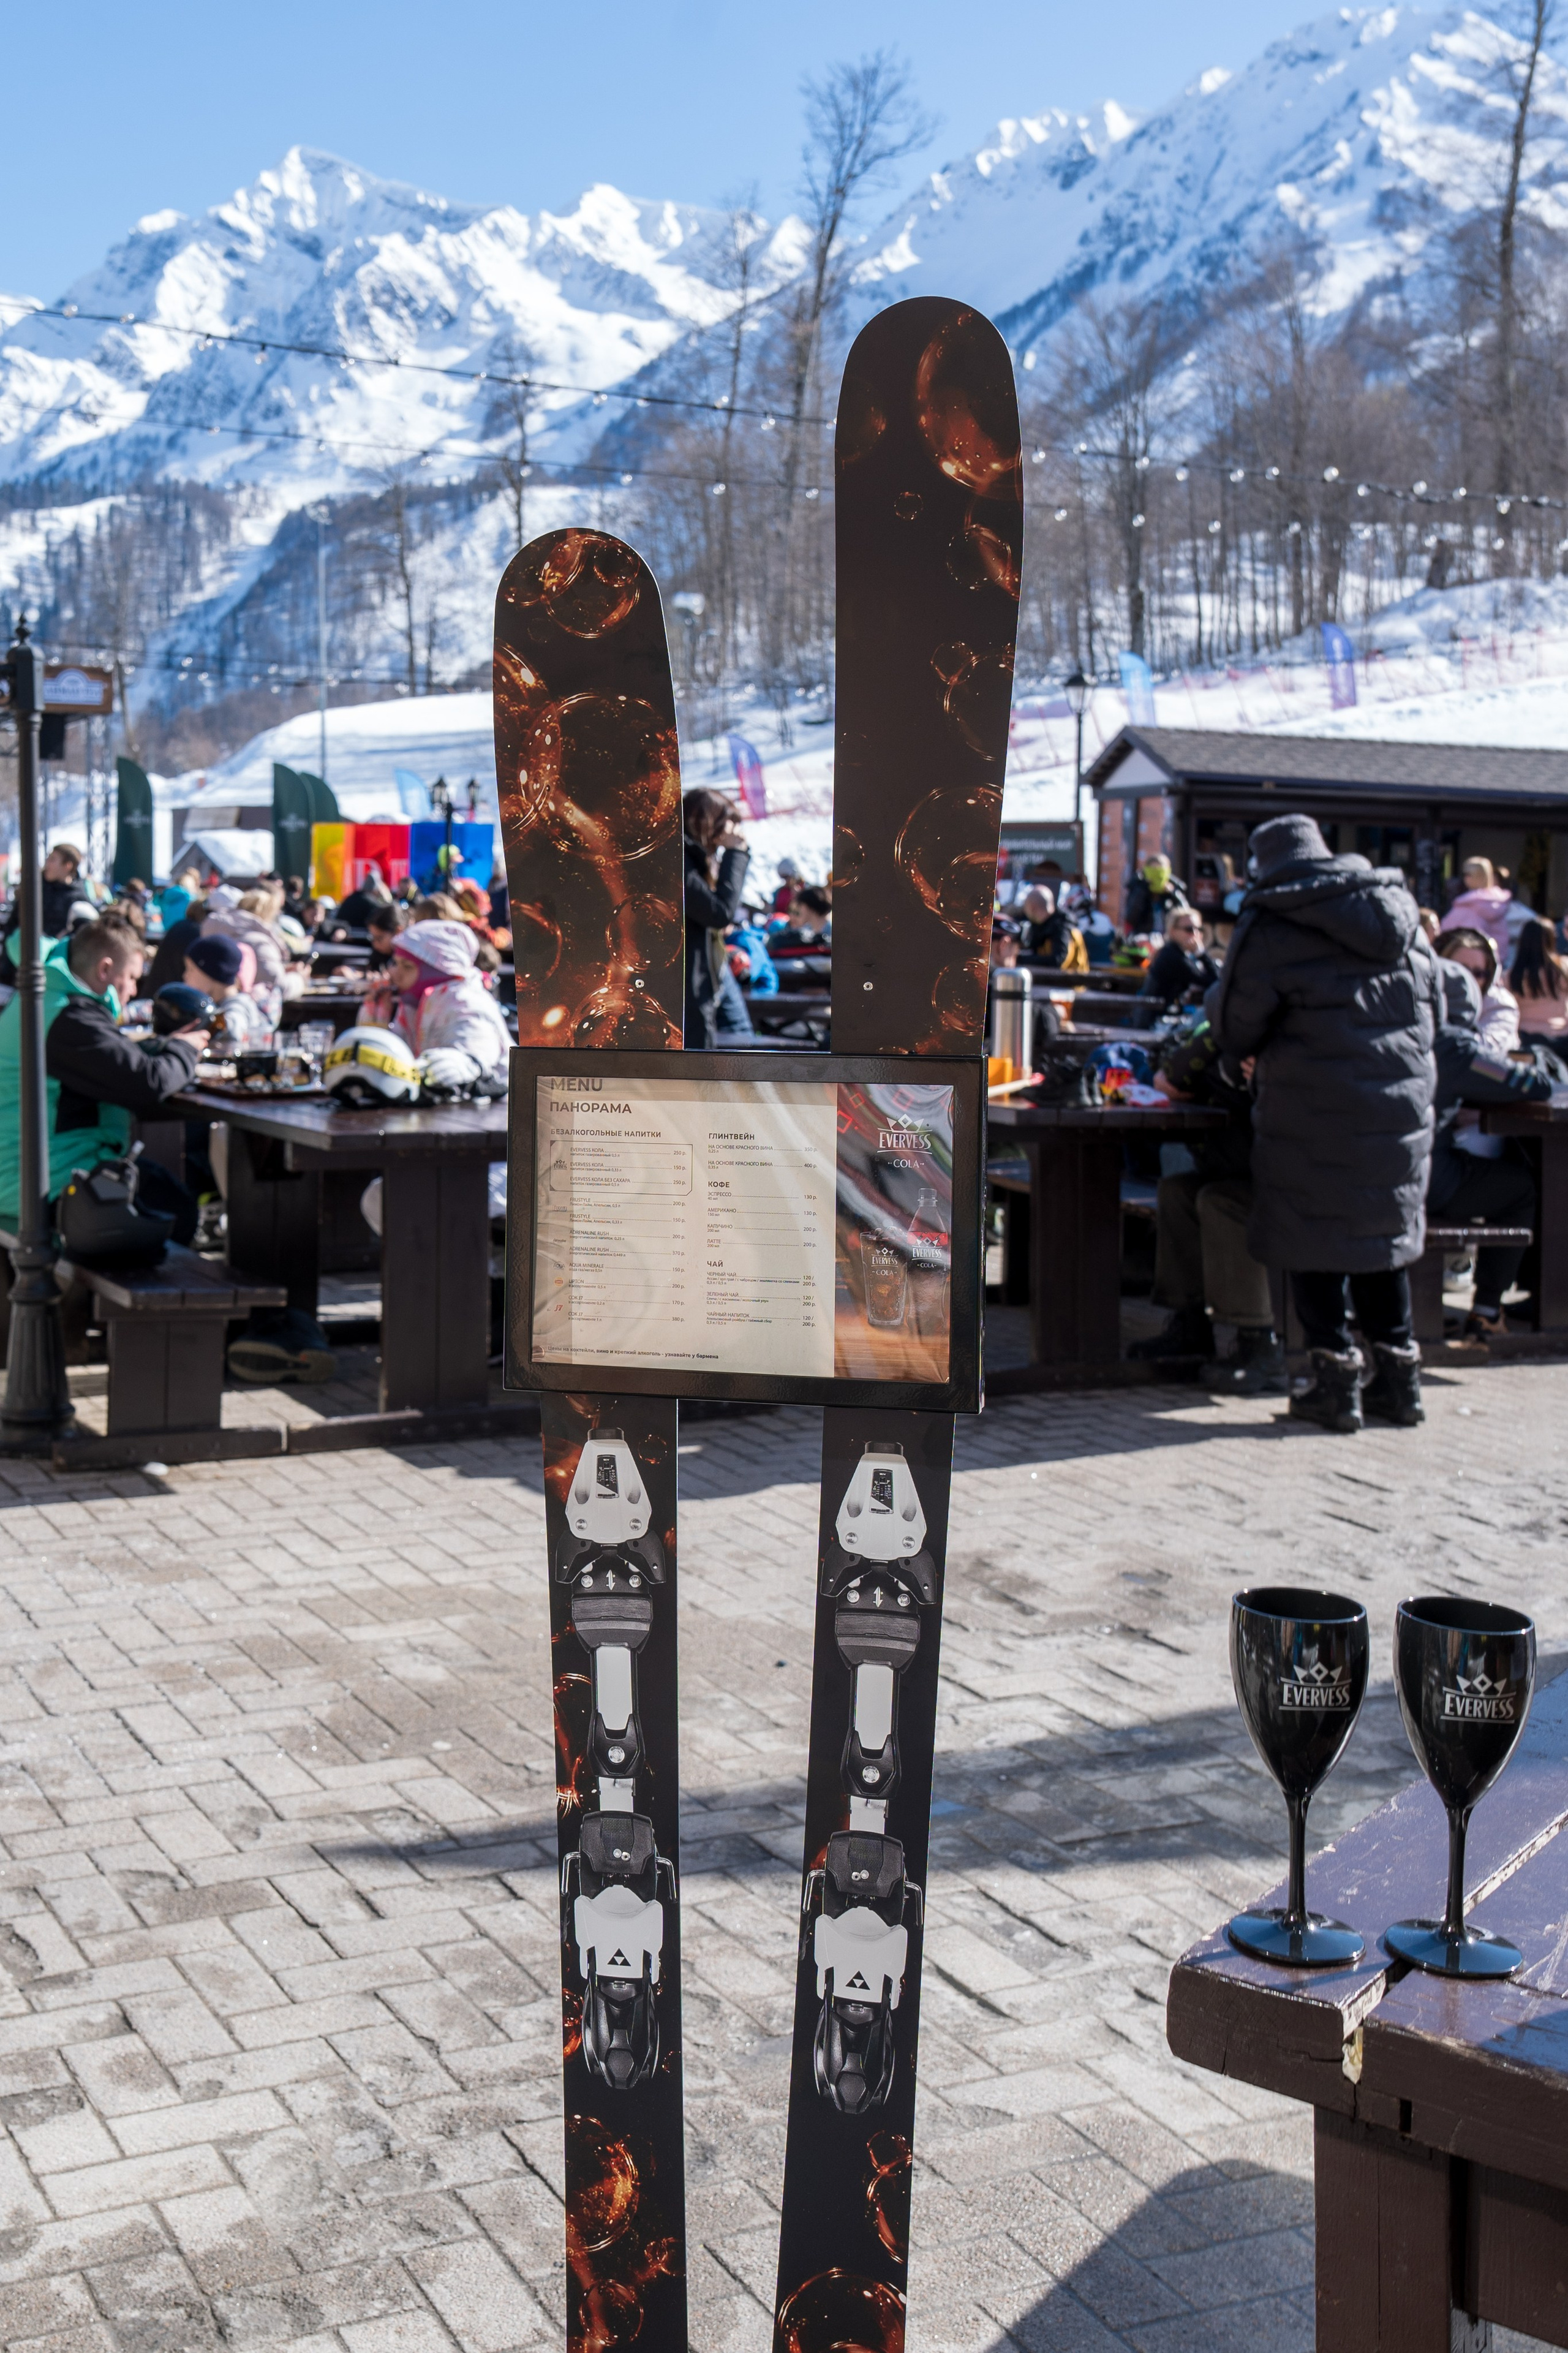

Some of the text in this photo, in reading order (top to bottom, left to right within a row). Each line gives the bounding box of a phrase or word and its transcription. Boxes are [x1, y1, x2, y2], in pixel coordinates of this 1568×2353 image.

[552, 1078, 603, 1091] MENU
[550, 1102, 632, 1114] ПАНОРАМА
[879, 1132, 931, 1150] EVERVESS
[894, 1159, 919, 1168] COLA
[913, 1248, 942, 1258] EVERVESS
[1283, 1683, 1351, 1707] EVERVESS
[1444, 1693, 1515, 1720] EVERVESS
